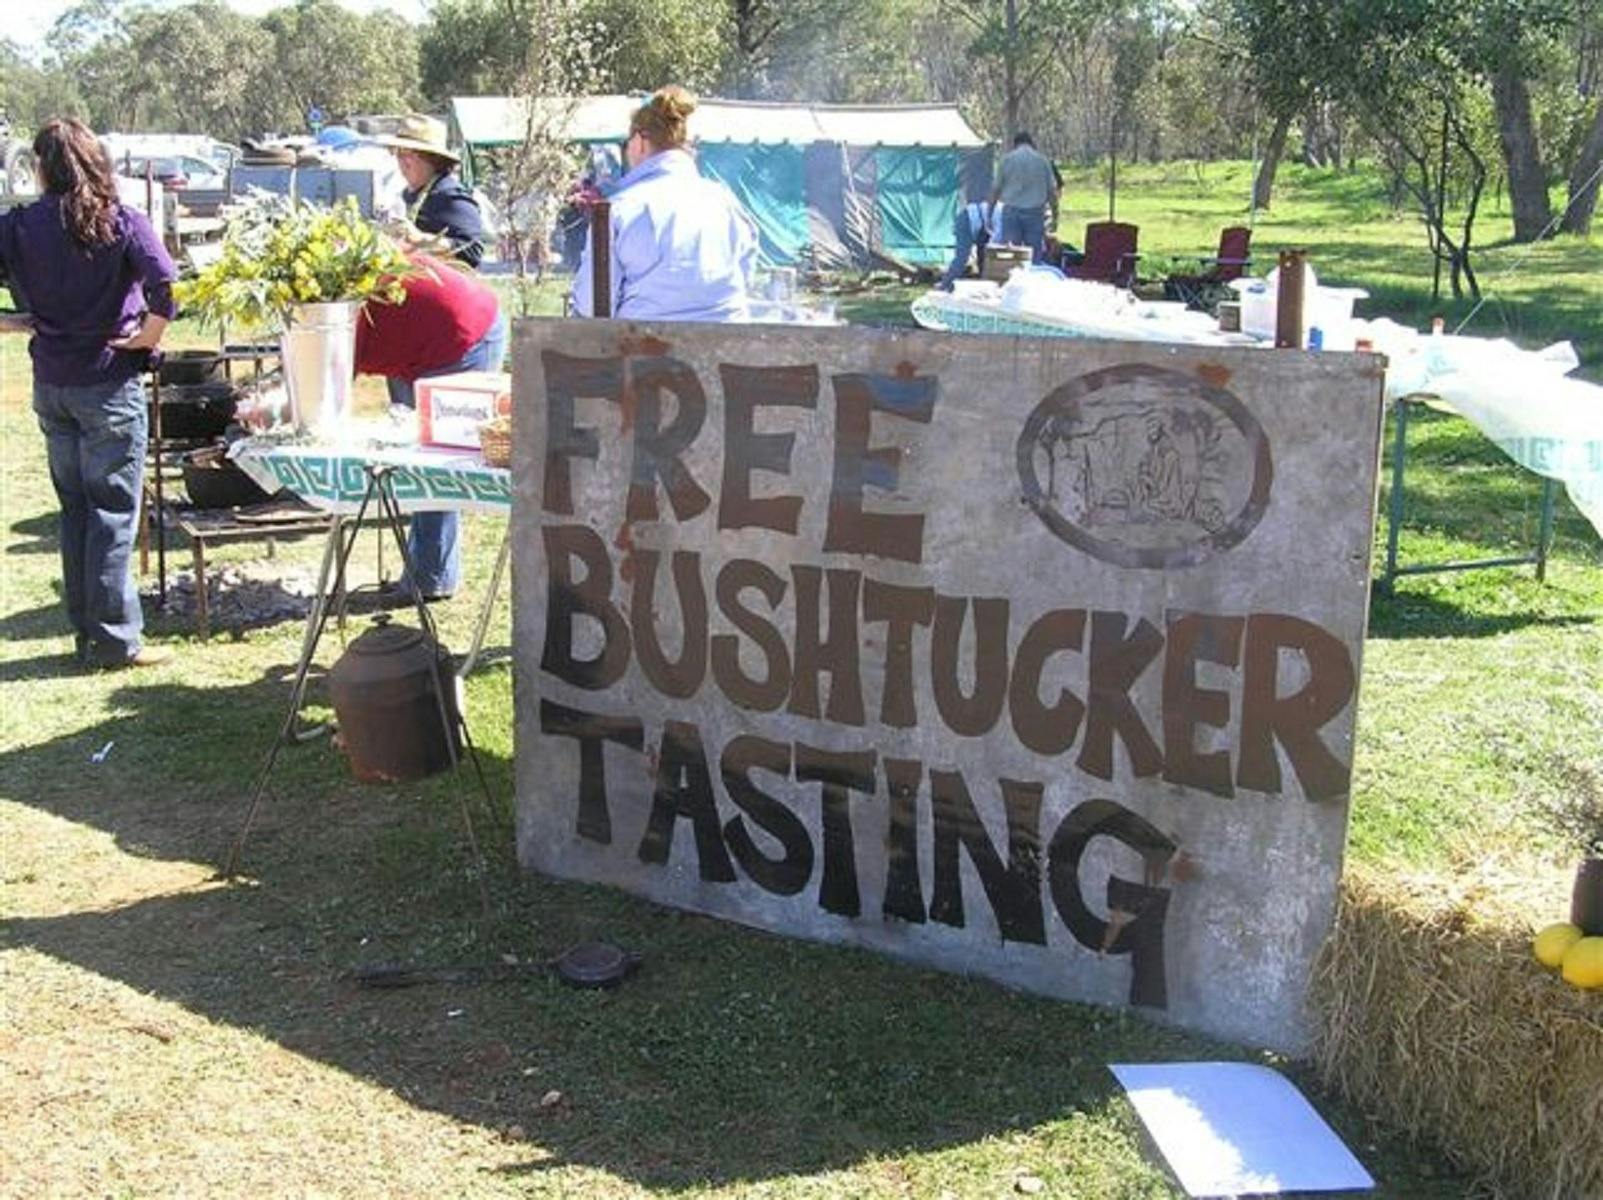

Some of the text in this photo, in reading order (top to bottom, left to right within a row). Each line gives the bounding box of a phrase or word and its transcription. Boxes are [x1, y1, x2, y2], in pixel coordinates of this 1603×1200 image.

[541, 350, 937, 564] FREE
[540, 525, 1358, 802] BUSHTUCKER
[540, 701, 1177, 1009] TASTING
